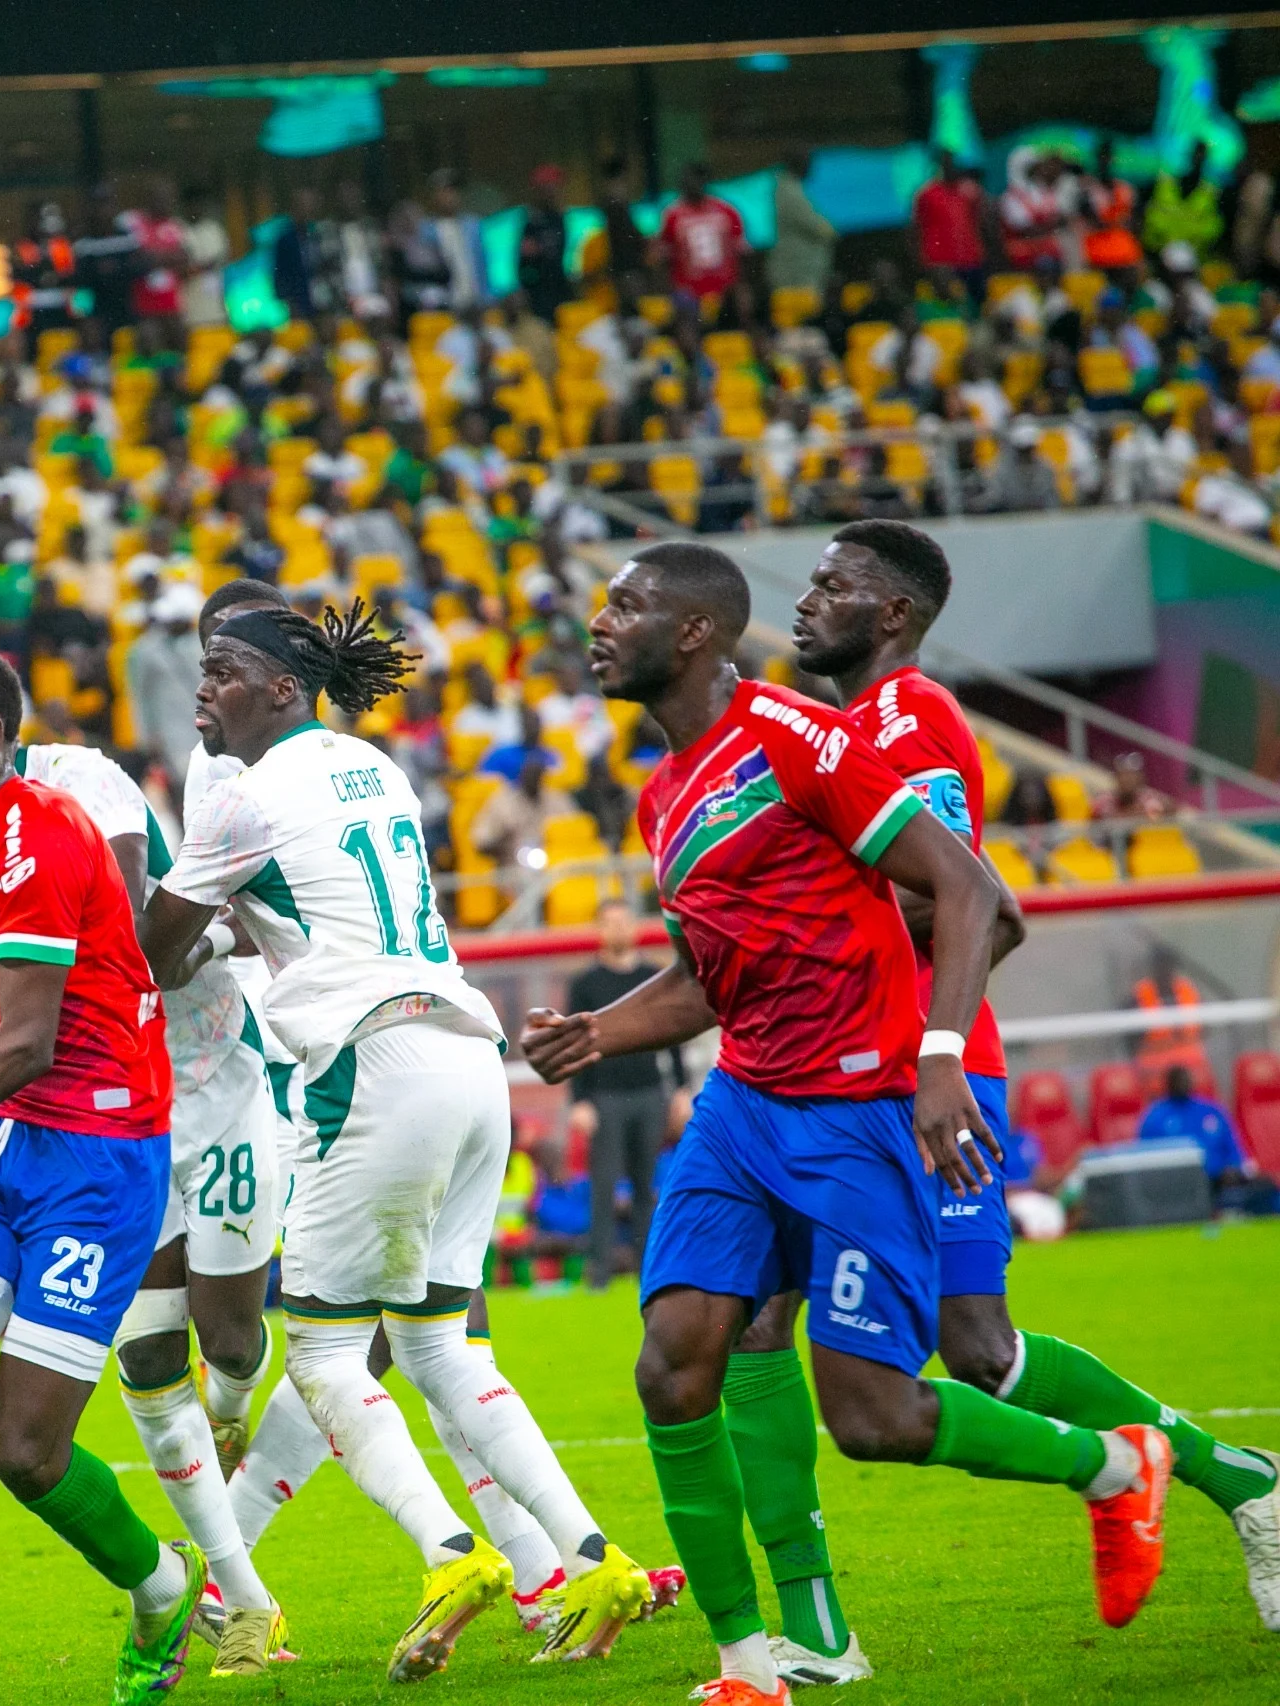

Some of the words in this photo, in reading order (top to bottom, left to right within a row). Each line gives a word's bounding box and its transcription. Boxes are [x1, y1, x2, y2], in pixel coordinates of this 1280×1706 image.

[331, 767, 386, 803] CHERIF
[338, 813, 450, 964] 12
[198, 1142, 257, 1217] 28
[39, 1235, 106, 1300] 23
[830, 1249, 869, 1311] 6
